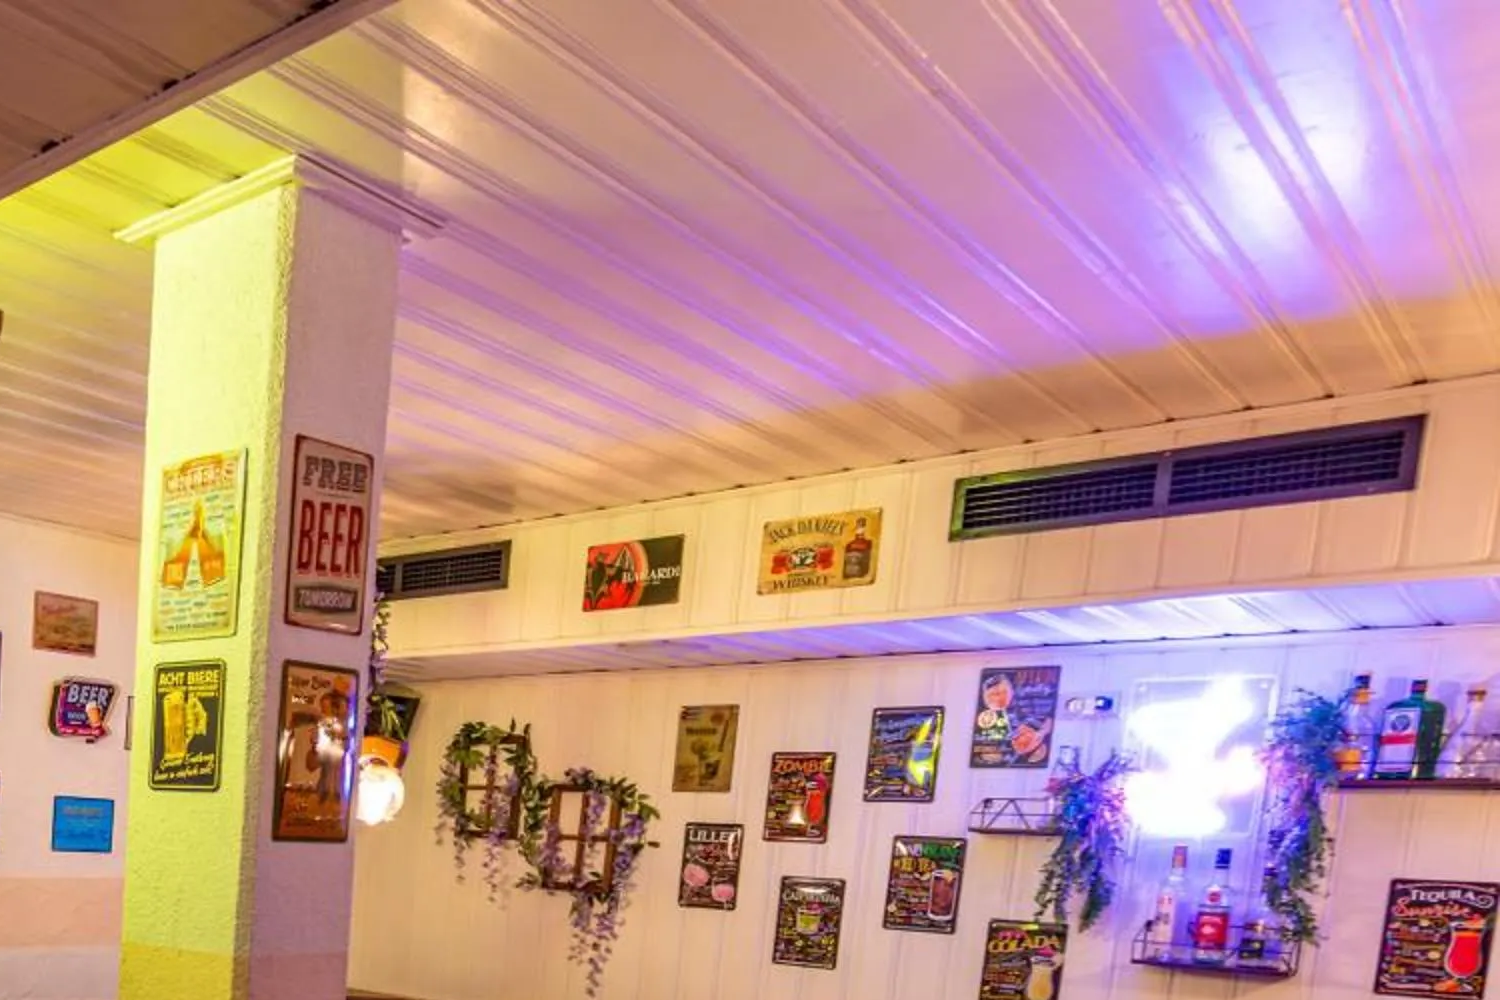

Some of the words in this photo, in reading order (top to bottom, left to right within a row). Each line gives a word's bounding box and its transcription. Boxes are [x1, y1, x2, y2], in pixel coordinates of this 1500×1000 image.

[303, 456, 368, 493] FREE
[297, 499, 364, 576] BEER
[300, 588, 354, 609] TOMORROW
[159, 671, 185, 686] ACHT
[187, 669, 219, 685] BIERE
[67, 684, 109, 707] BEER
[688, 828, 739, 843] LILLE
[1411, 888, 1477, 903] TEQUILA
[1392, 896, 1471, 917] Sunrise
[988, 934, 1062, 953] COLADA
